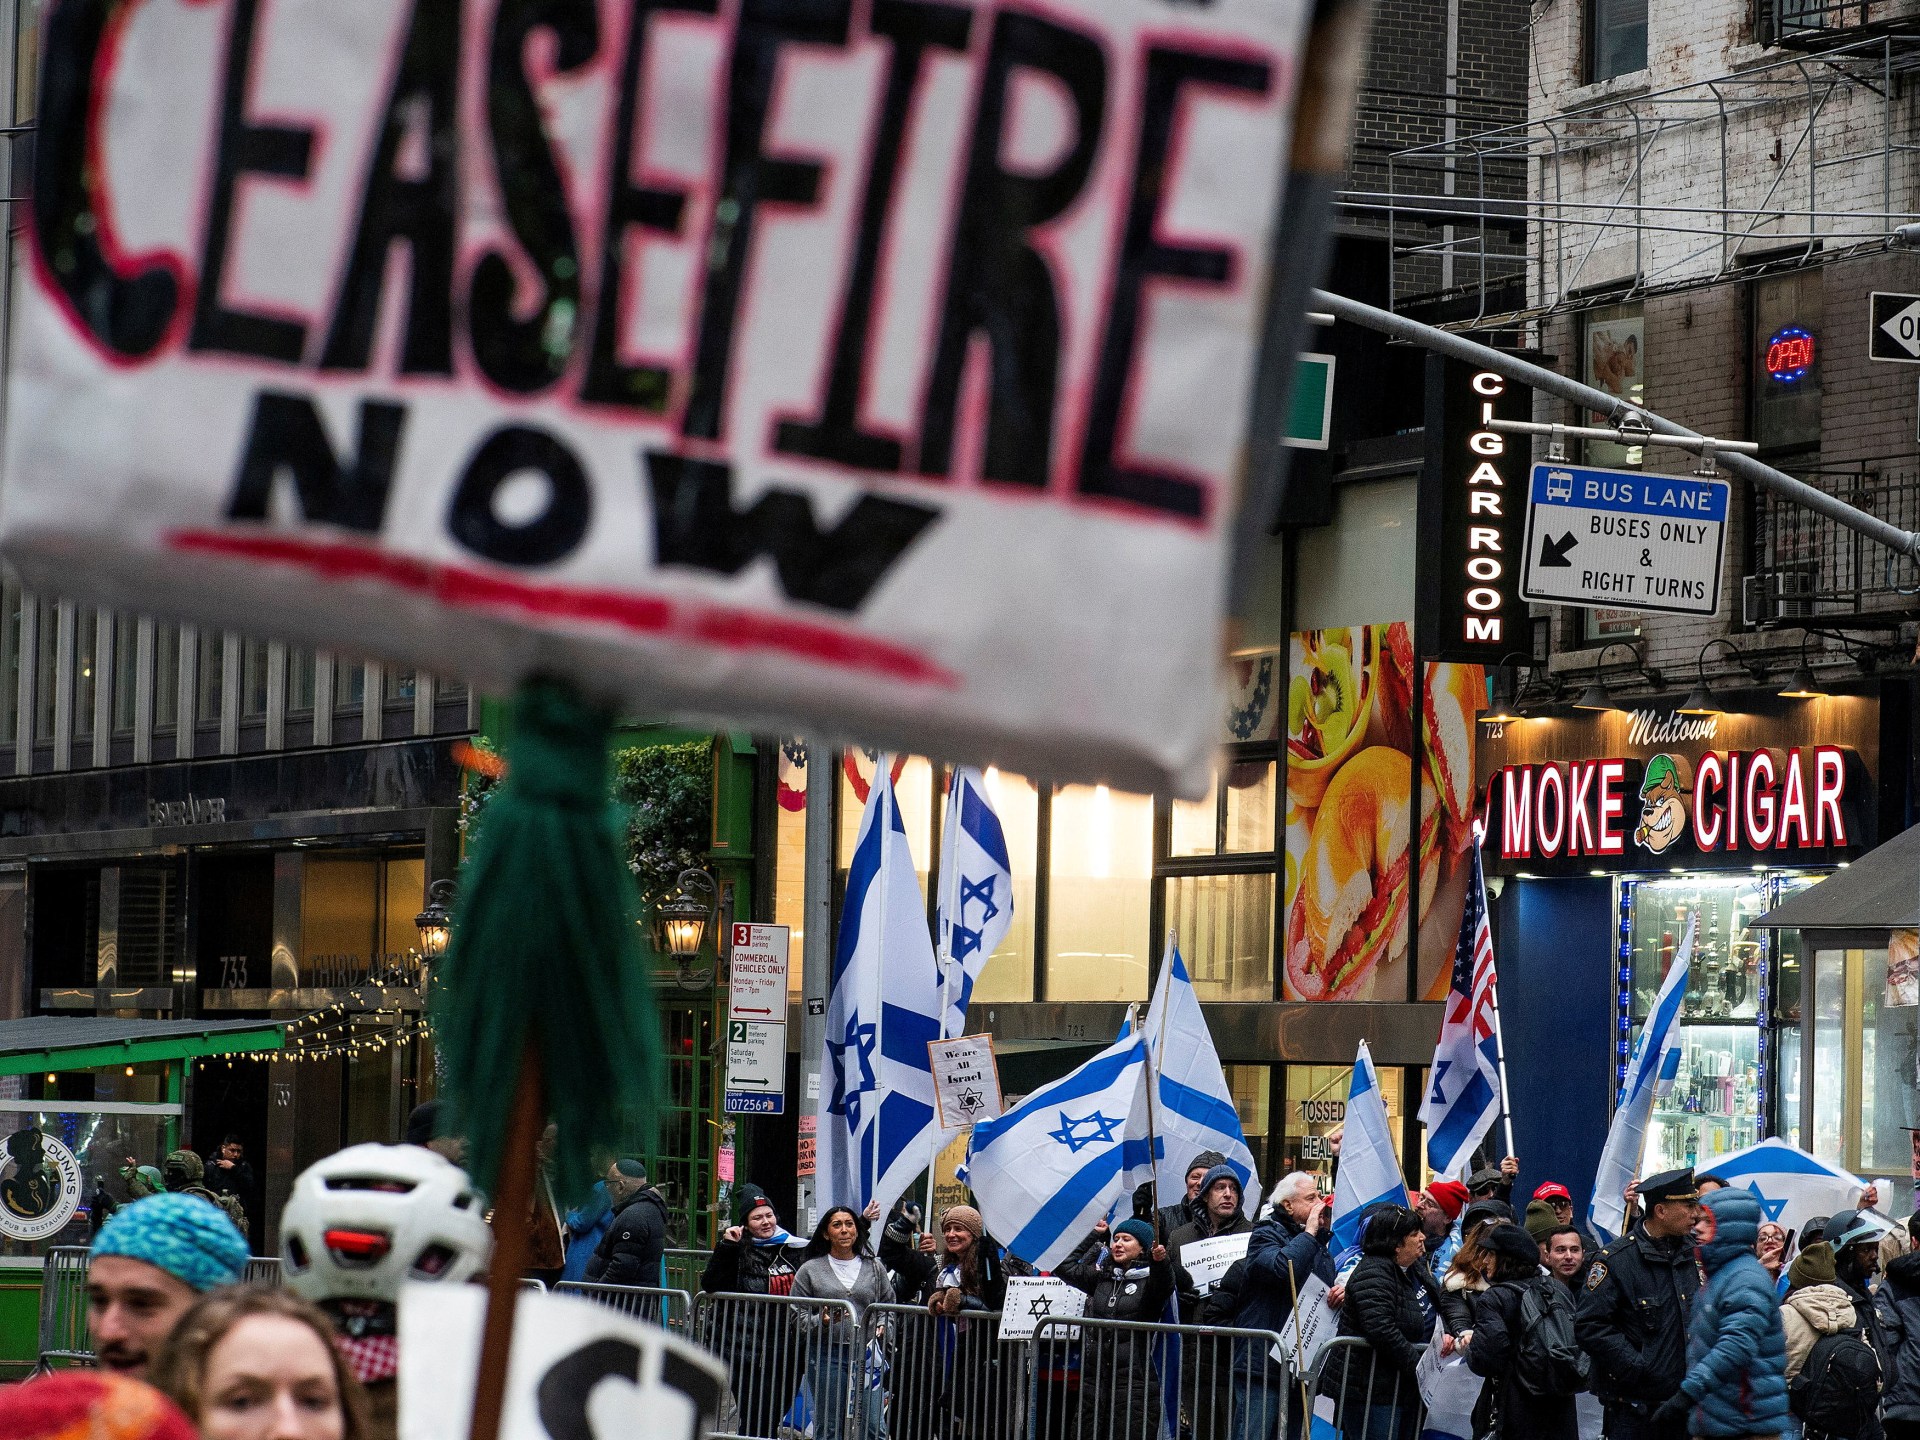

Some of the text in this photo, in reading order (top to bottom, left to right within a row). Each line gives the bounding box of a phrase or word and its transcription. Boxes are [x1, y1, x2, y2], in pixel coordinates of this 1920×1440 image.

[26, 0, 1280, 530] CEASEFIRE
[1767, 337, 1813, 373] OPEN
[224, 386, 945, 617] NOW
[1584, 480, 1712, 511] BUS LANE
[1466, 372, 1504, 641] CIGAR ROOM
[1590, 515, 1707, 545] BUSES ONLY
[1639, 548, 1653, 568] &
[1581, 570, 1706, 600] RIGHT TURNS
[1621, 622, 1632, 631] SPA
[1486, 723, 1503, 739] 723
[1626, 709, 1717, 746] Midtown
[1693, 745, 1848, 853] CIGAR
[738, 926, 748, 945] 3
[735, 953, 778, 964] COMMERCIAL
[220, 956, 248, 989] 733
[311, 954, 359, 988] THIRD
[735, 964, 785, 975] VEHICLES ONLY
[734, 977, 754, 985] Monday
[760, 978, 776, 987] Friday
[749, 986, 760, 994] 7pm
[733, 1022, 743, 1041] 2
[1067, 1025, 1085, 1037] 725
[748, 1038, 765, 1046] parking
[730, 1048, 755, 1057] Saturday
[730, 1057, 741, 1065] 9am
[746, 1057, 758, 1066] 7pm
[945, 1049, 978, 1059] We are
[956, 1061, 970, 1070] All
[947, 1071, 982, 1085] Israel
[727, 1098, 761, 1111] 107256
[1300, 1100, 1345, 1122] TOSSED
[800, 1140, 809, 1150] NO
[46, 1143, 77, 1196] DUNN'S
[4, 1221, 20, 1231] PUB
[31, 1200, 71, 1232] RESTAURANT
[1009, 1279, 1063, 1287] We Stand with
[1282, 1322, 1293, 1339] STAND
[1302, 1315, 1321, 1350] ZIONIST!
